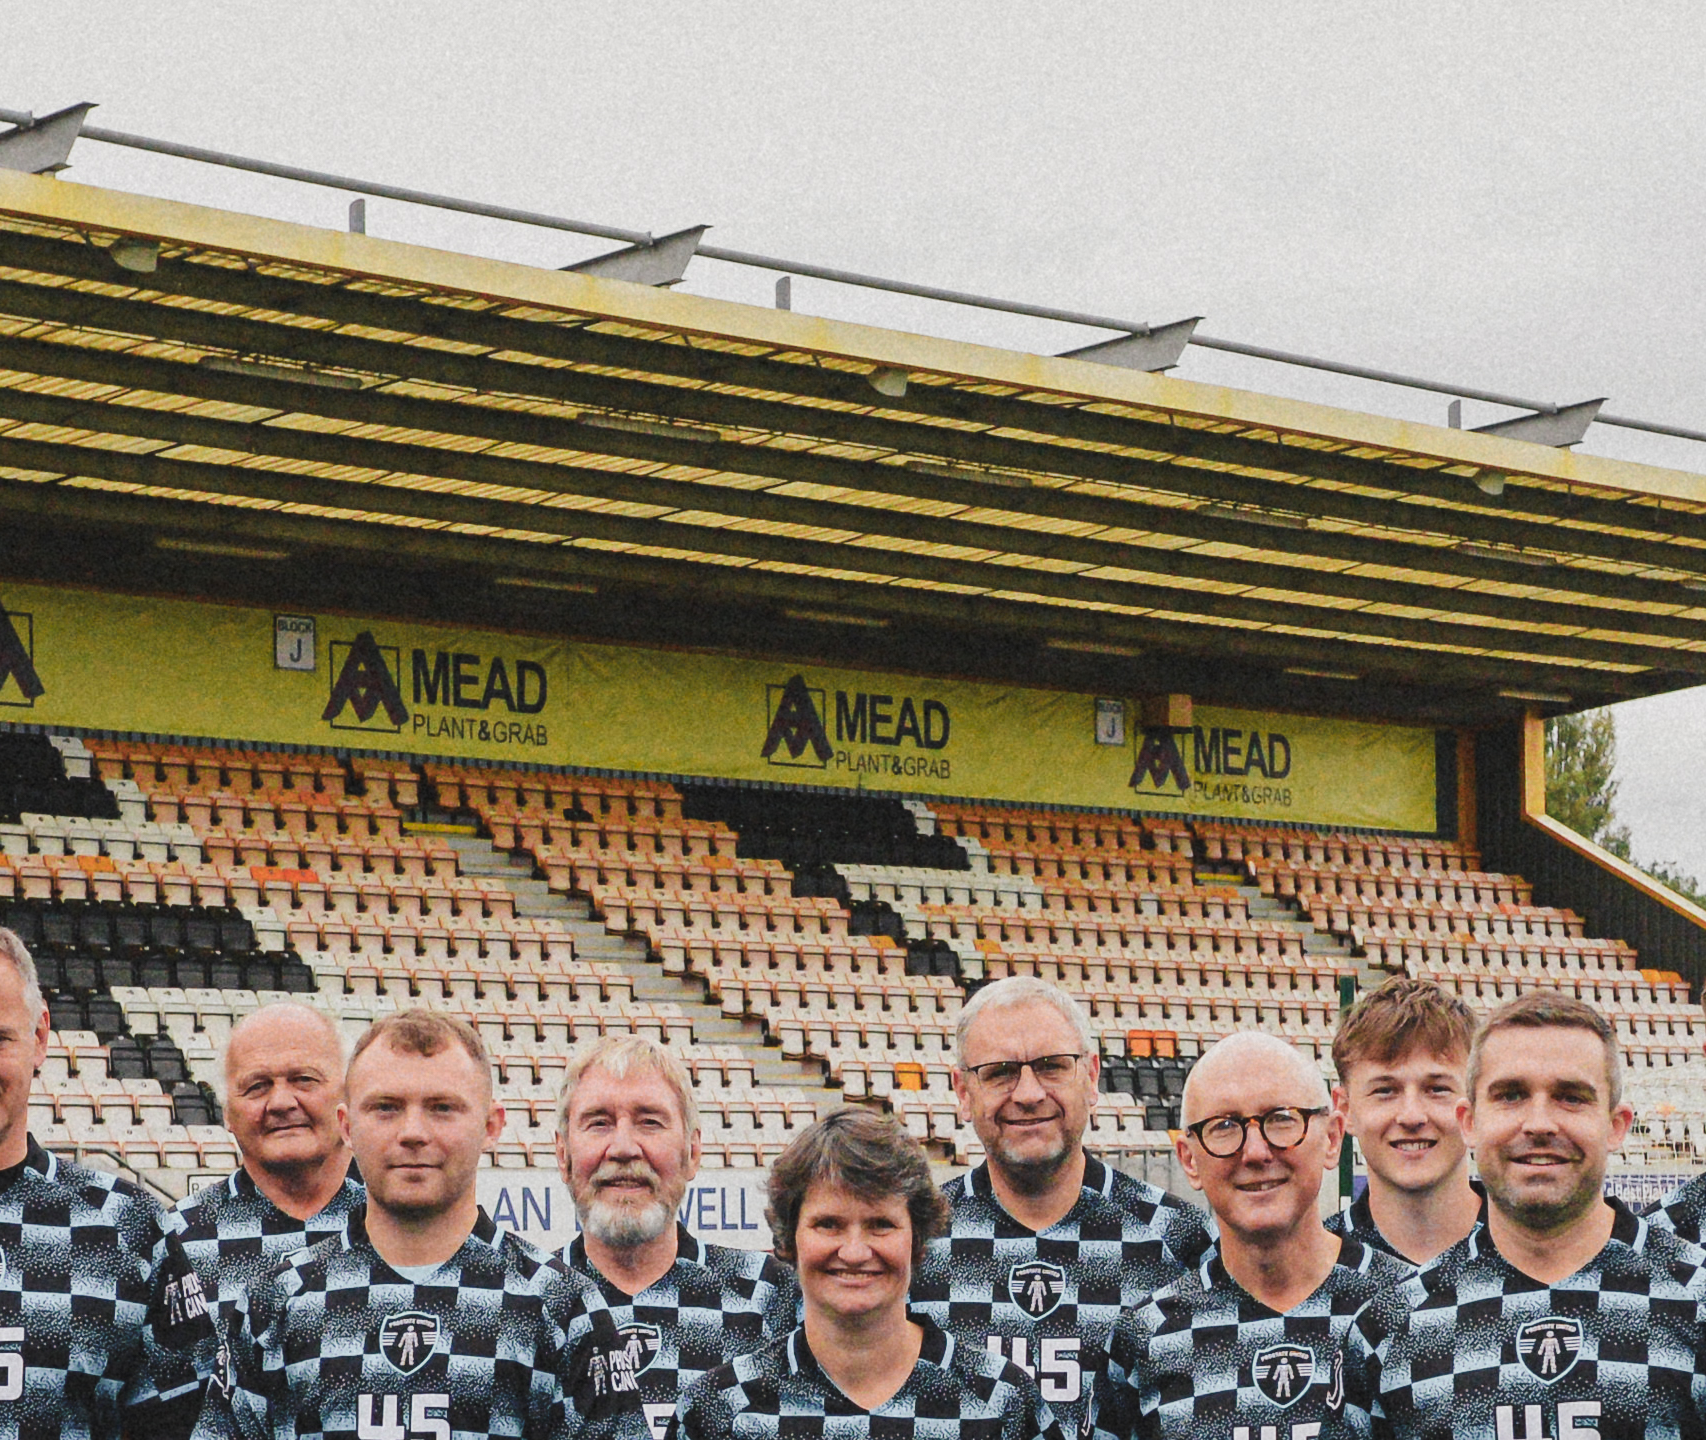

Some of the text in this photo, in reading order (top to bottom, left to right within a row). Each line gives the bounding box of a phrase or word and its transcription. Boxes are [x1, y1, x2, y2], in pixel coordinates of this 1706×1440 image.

[289, 638, 302, 663] J
[411, 648, 548, 715] MEAD
[412, 713, 548, 747] PLANT&GRAB
[835, 690, 951, 751] MEAD
[835, 750, 951, 779] PLANT&GRAB
[1193, 725, 1292, 779] MEAD
[1193, 780, 1292, 807] PLANT&GRAB
